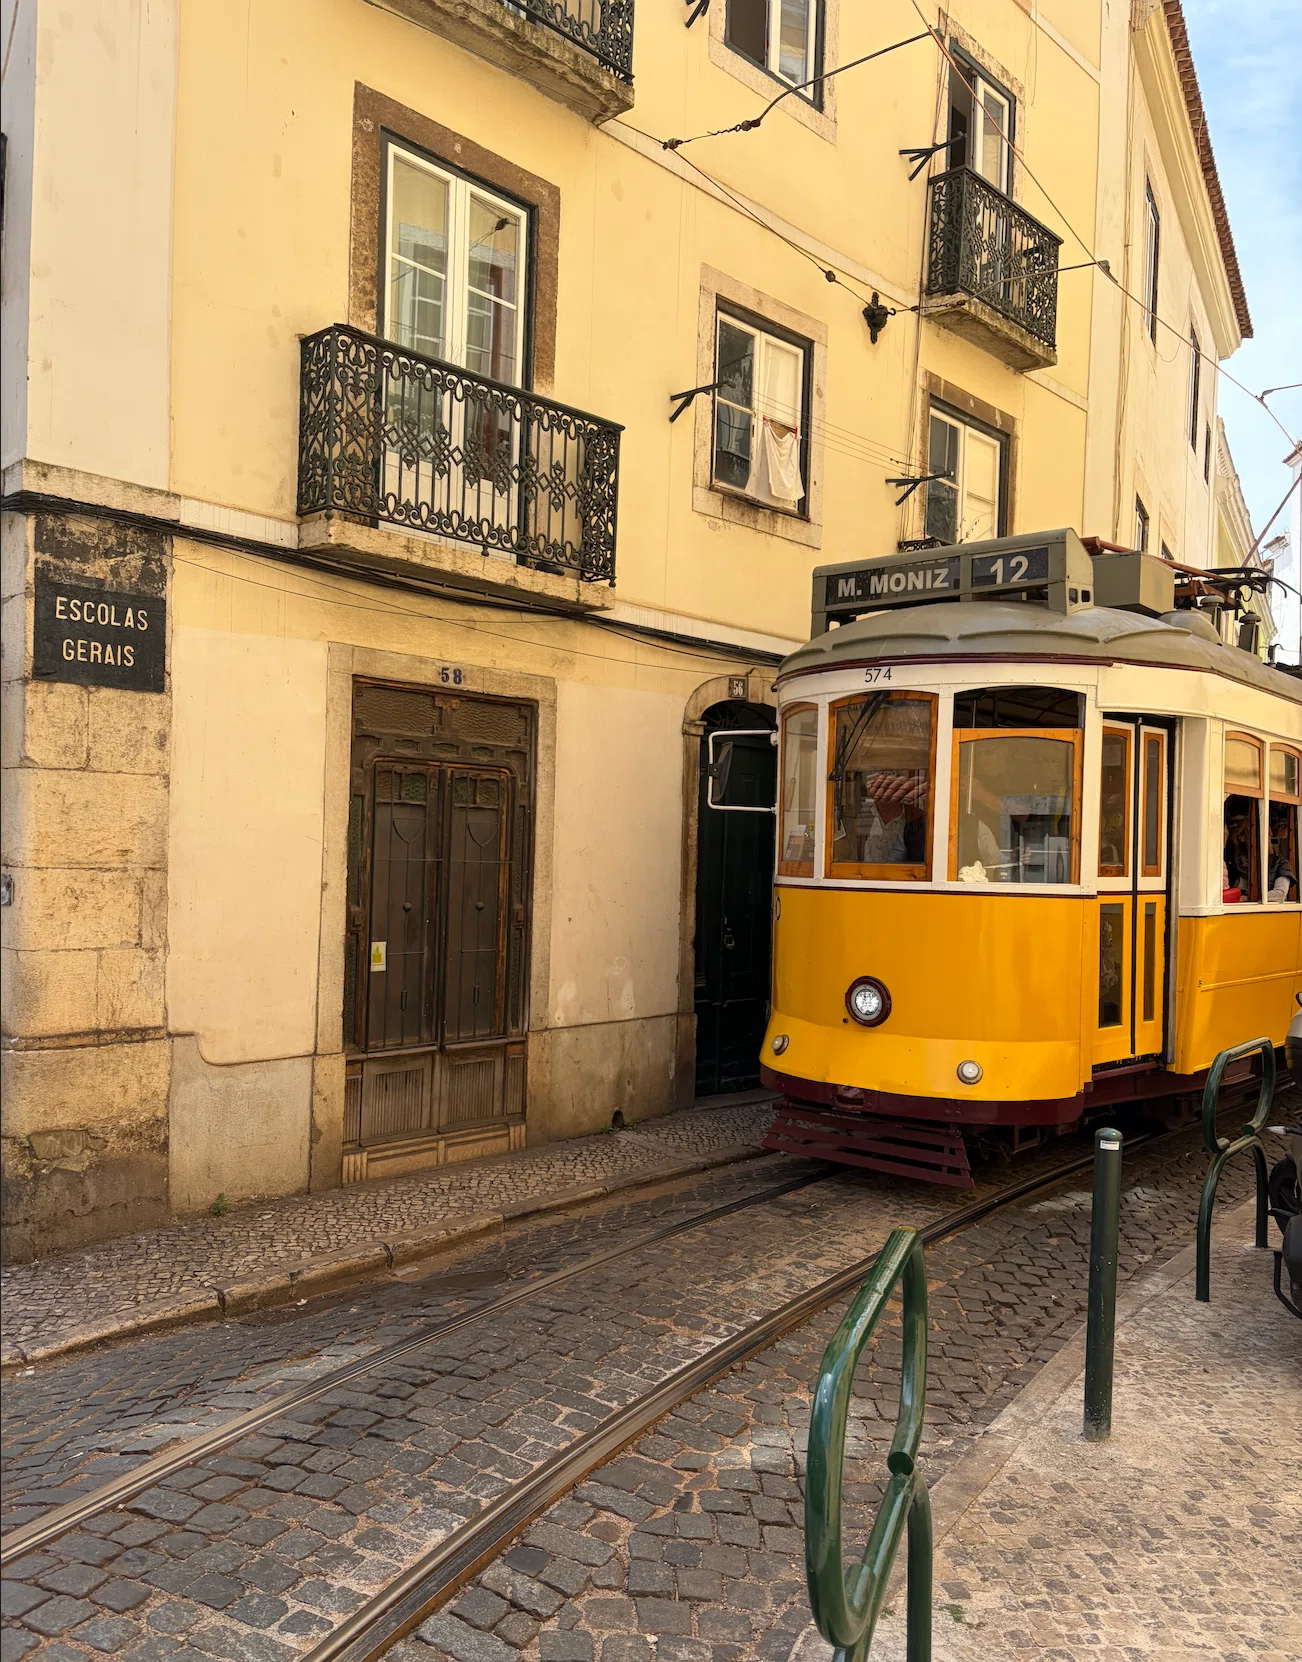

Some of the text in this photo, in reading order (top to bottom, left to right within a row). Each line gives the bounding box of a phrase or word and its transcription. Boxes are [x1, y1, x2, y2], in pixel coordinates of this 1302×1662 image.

[838, 568, 949, 598] M. MONIZ
[990, 555, 1029, 585] 12
[55, 596, 148, 631] ESCOLAS
[62, 638, 135, 667] GERAIS
[441, 667, 463, 685] 58
[733, 680, 744, 696] 56
[864, 667, 892, 683] 574
